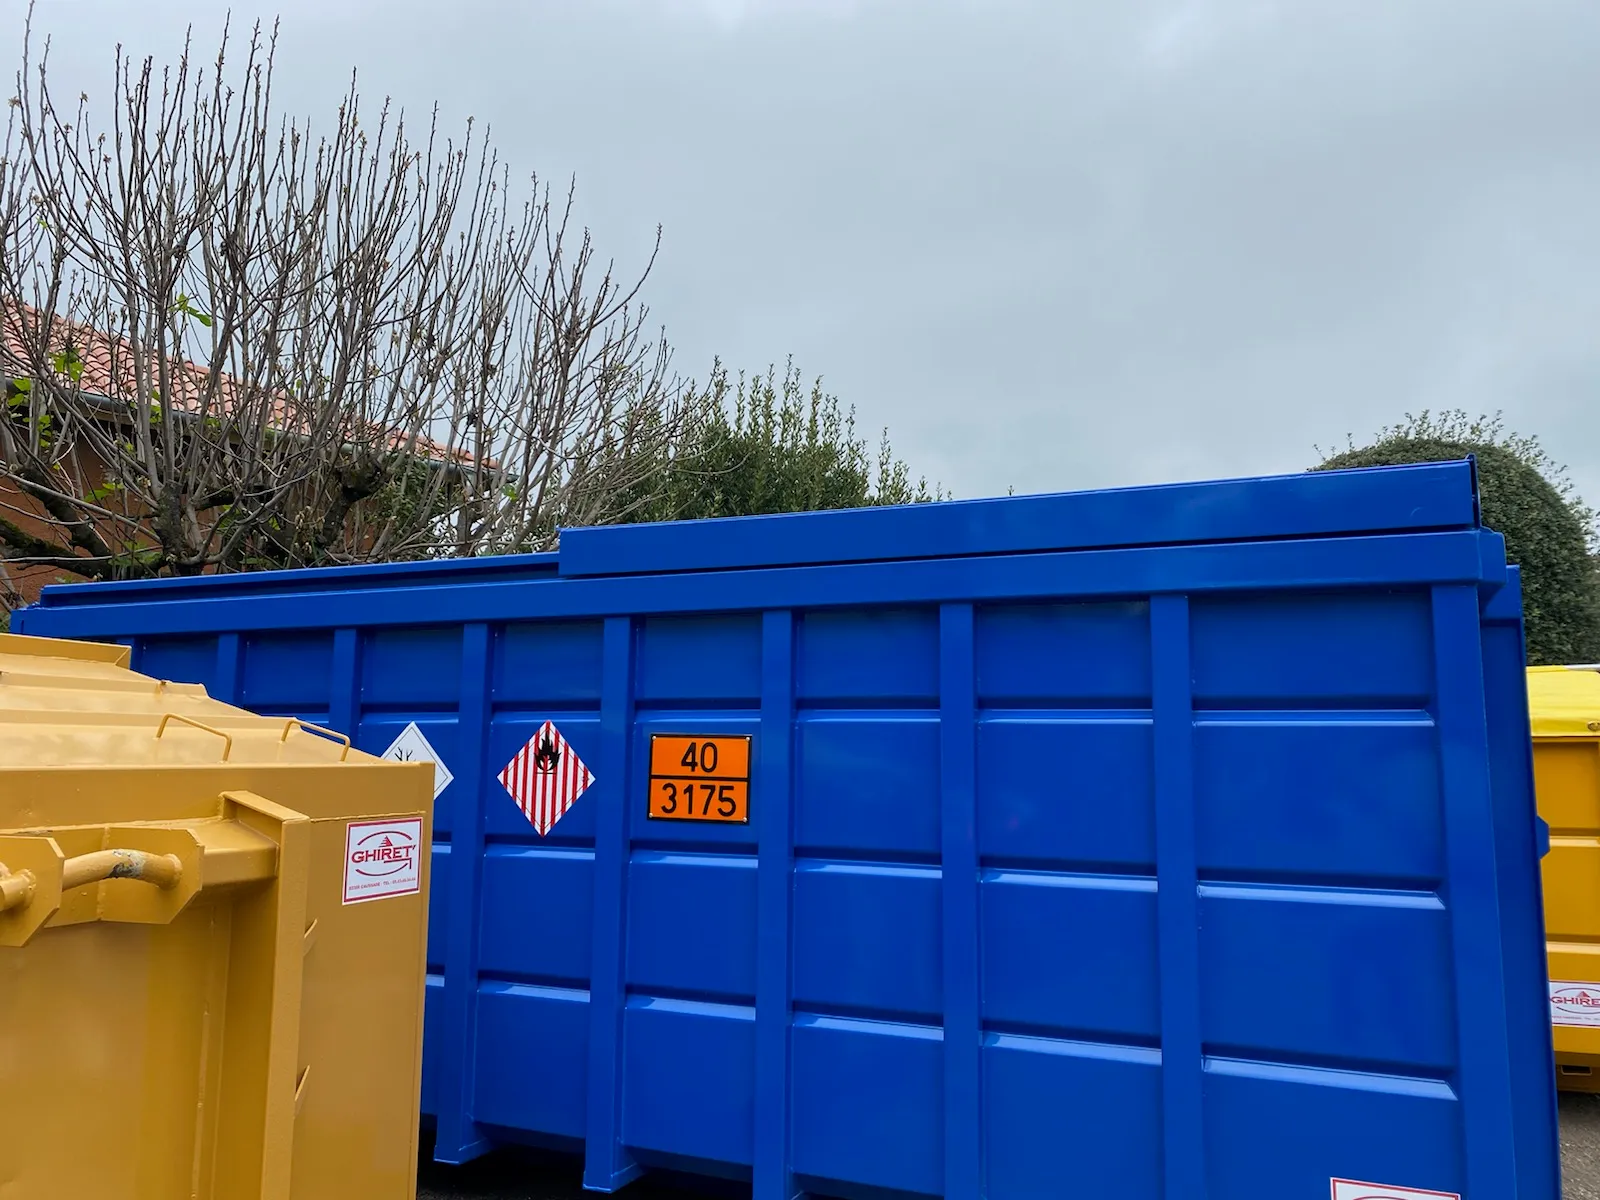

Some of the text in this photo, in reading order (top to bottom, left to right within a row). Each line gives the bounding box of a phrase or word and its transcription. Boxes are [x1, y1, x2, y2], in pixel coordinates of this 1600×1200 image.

[681, 742, 718, 773] 40
[661, 783, 737, 817] 3175
[1551, 996, 1600, 1007] GHIRE
